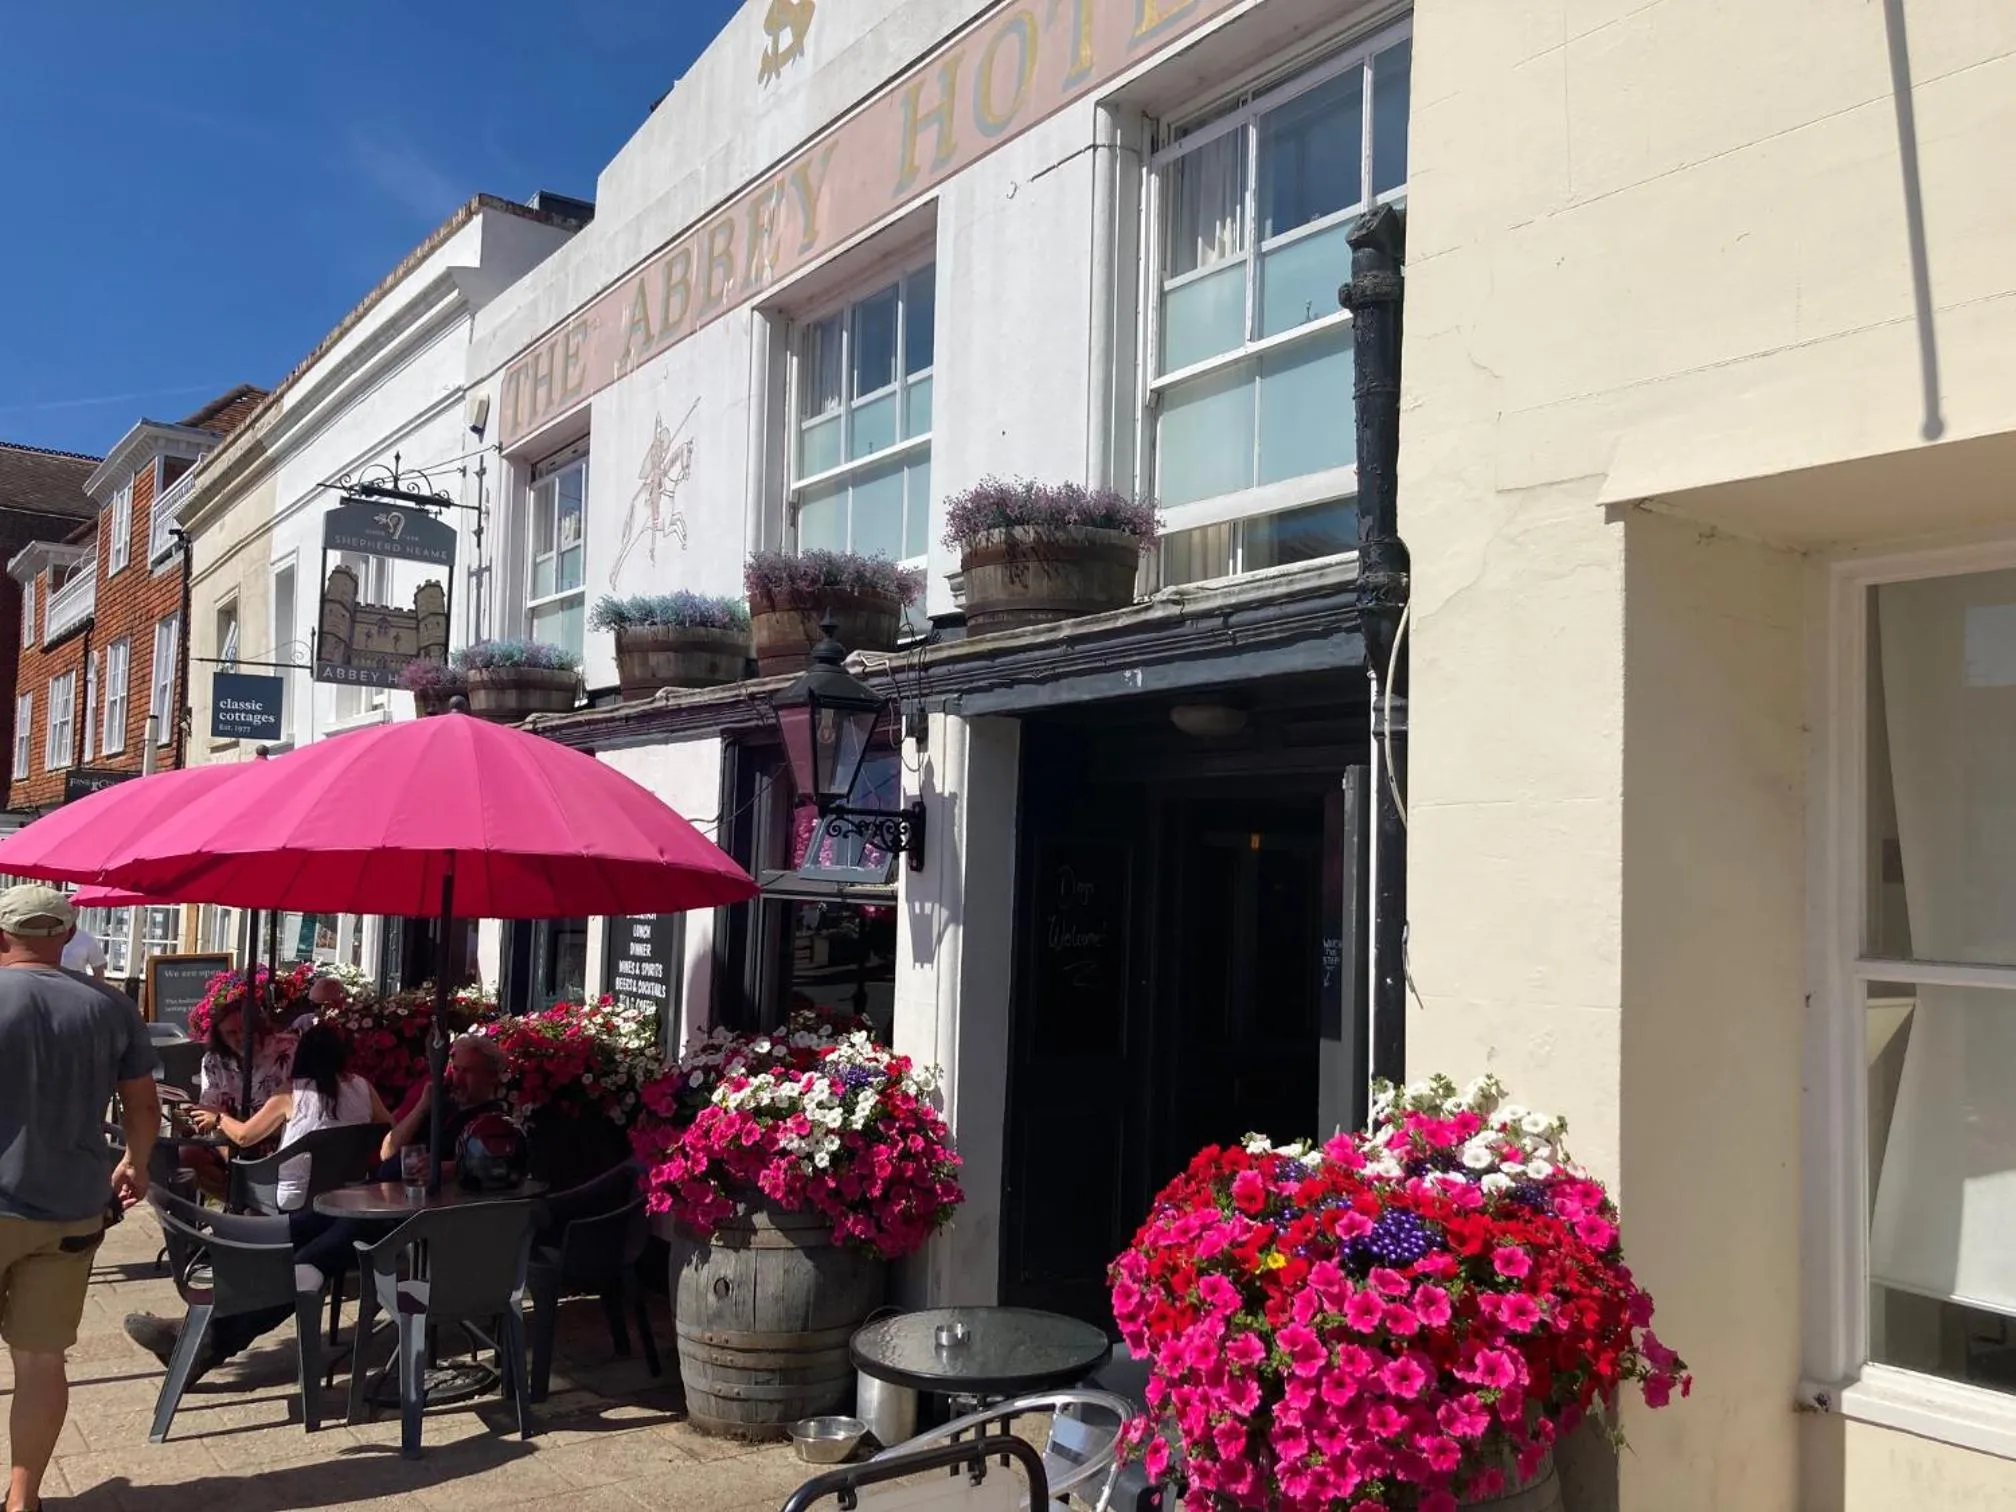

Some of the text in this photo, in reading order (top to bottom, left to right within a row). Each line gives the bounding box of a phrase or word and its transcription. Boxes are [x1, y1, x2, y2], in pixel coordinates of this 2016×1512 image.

[504, 320, 588, 437] THE
[617, 140, 840, 372] ABBEY
[334, 535, 401, 553] SHEPHERD
[405, 544, 448, 561] NEAME
[322, 666, 379, 682] ABBEY
[219, 698, 263, 711] classic
[219, 711, 276, 726] cottages
[633, 924, 651, 938] LUNCH
[630, 942, 651, 957] DINNER
[619, 960, 635, 975] WINES
[641, 962, 663, 978] SPIRITS
[615, 976, 633, 992] BEERS
[637, 980, 666, 998] COCKTAILS
